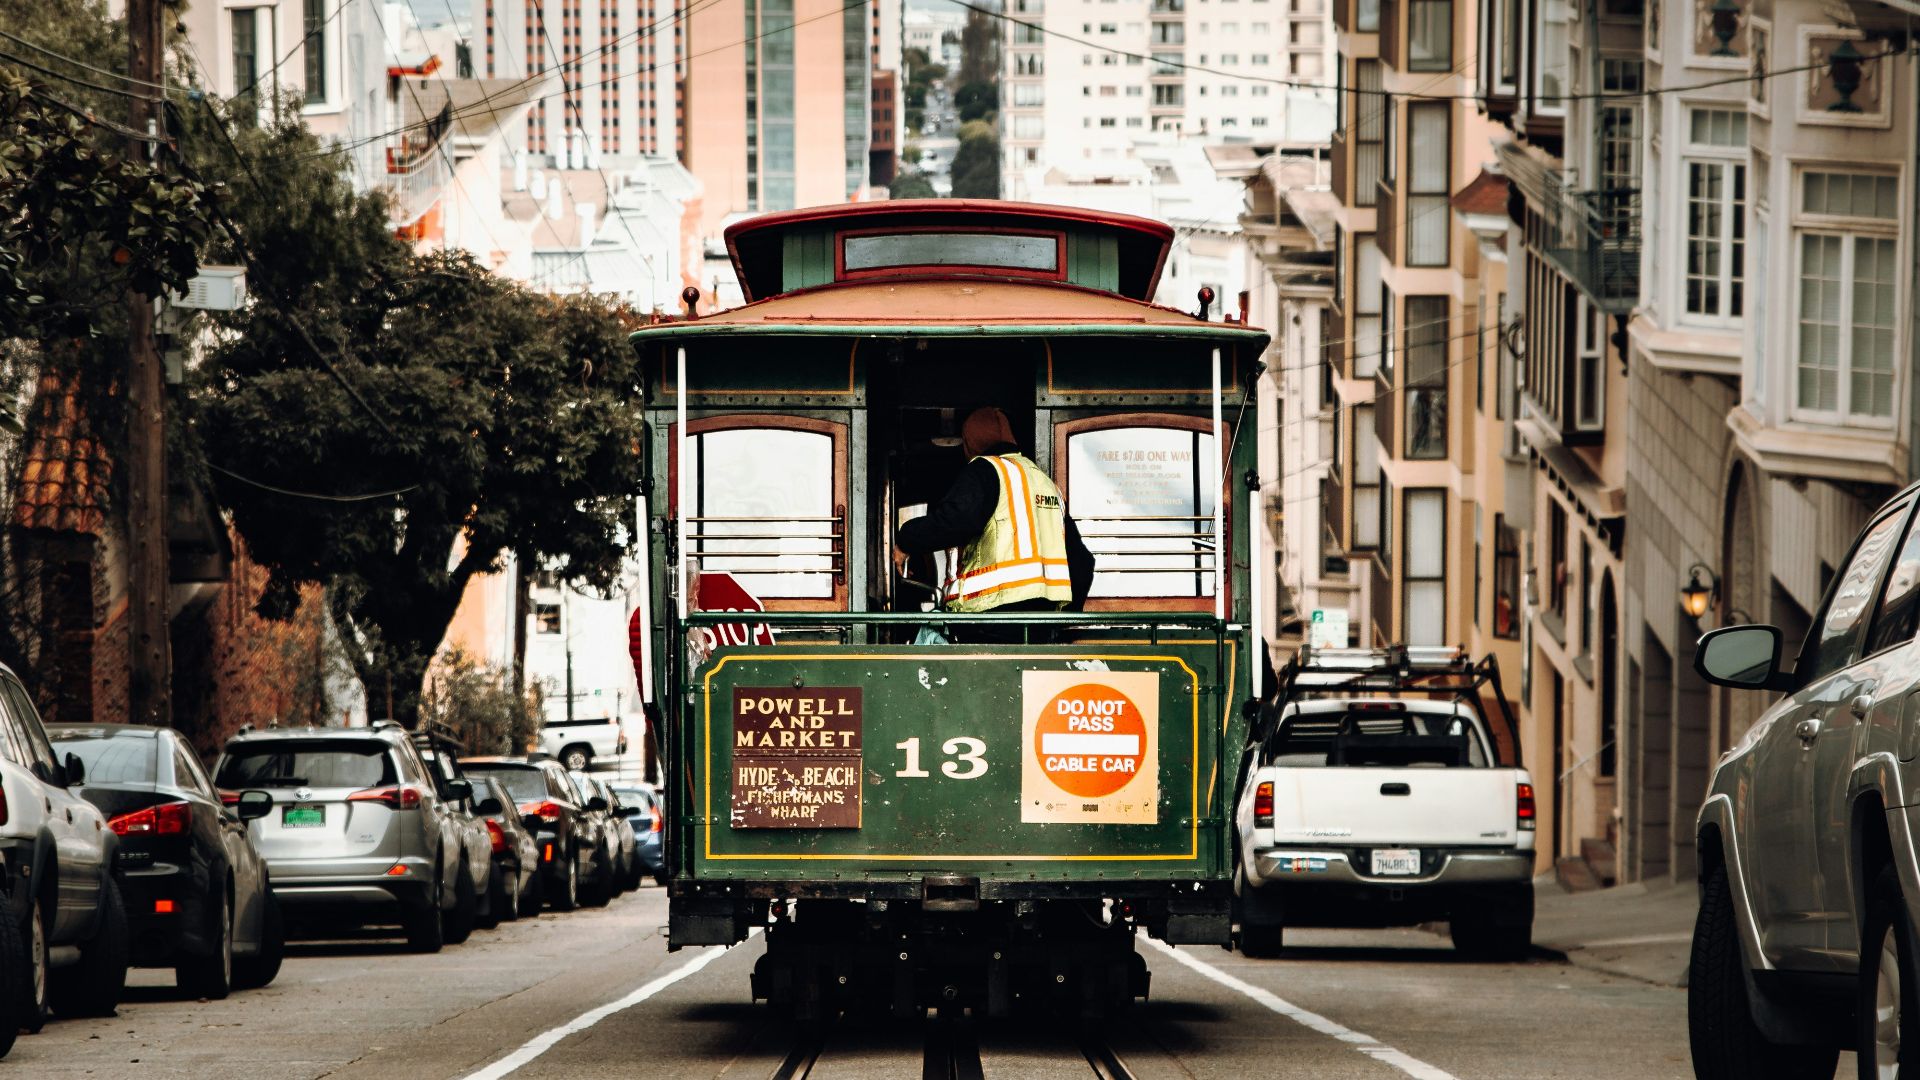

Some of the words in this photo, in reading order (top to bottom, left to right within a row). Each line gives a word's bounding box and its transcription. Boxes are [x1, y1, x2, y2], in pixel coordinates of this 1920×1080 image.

[1147, 451, 1168, 461] ONE
[1170, 451, 1192, 461] WAY
[1035, 494, 1059, 506] SFMTA
[740, 698, 854, 715] POWELL
[1057, 699, 1084, 715] DO
[1087, 700, 1126, 716] NOT
[769, 716, 825, 729] AND
[1068, 716, 1115, 732] PASS
[737, 730, 856, 747] MARKET
[895, 736, 989, 779] 13
[1045, 756, 1098, 772] CABLE
[1101, 757, 1136, 773] CAR
[738, 767, 778, 786] HYDE
[803, 767, 855, 786] BEACH
[770, 805, 820, 818] WHARF
